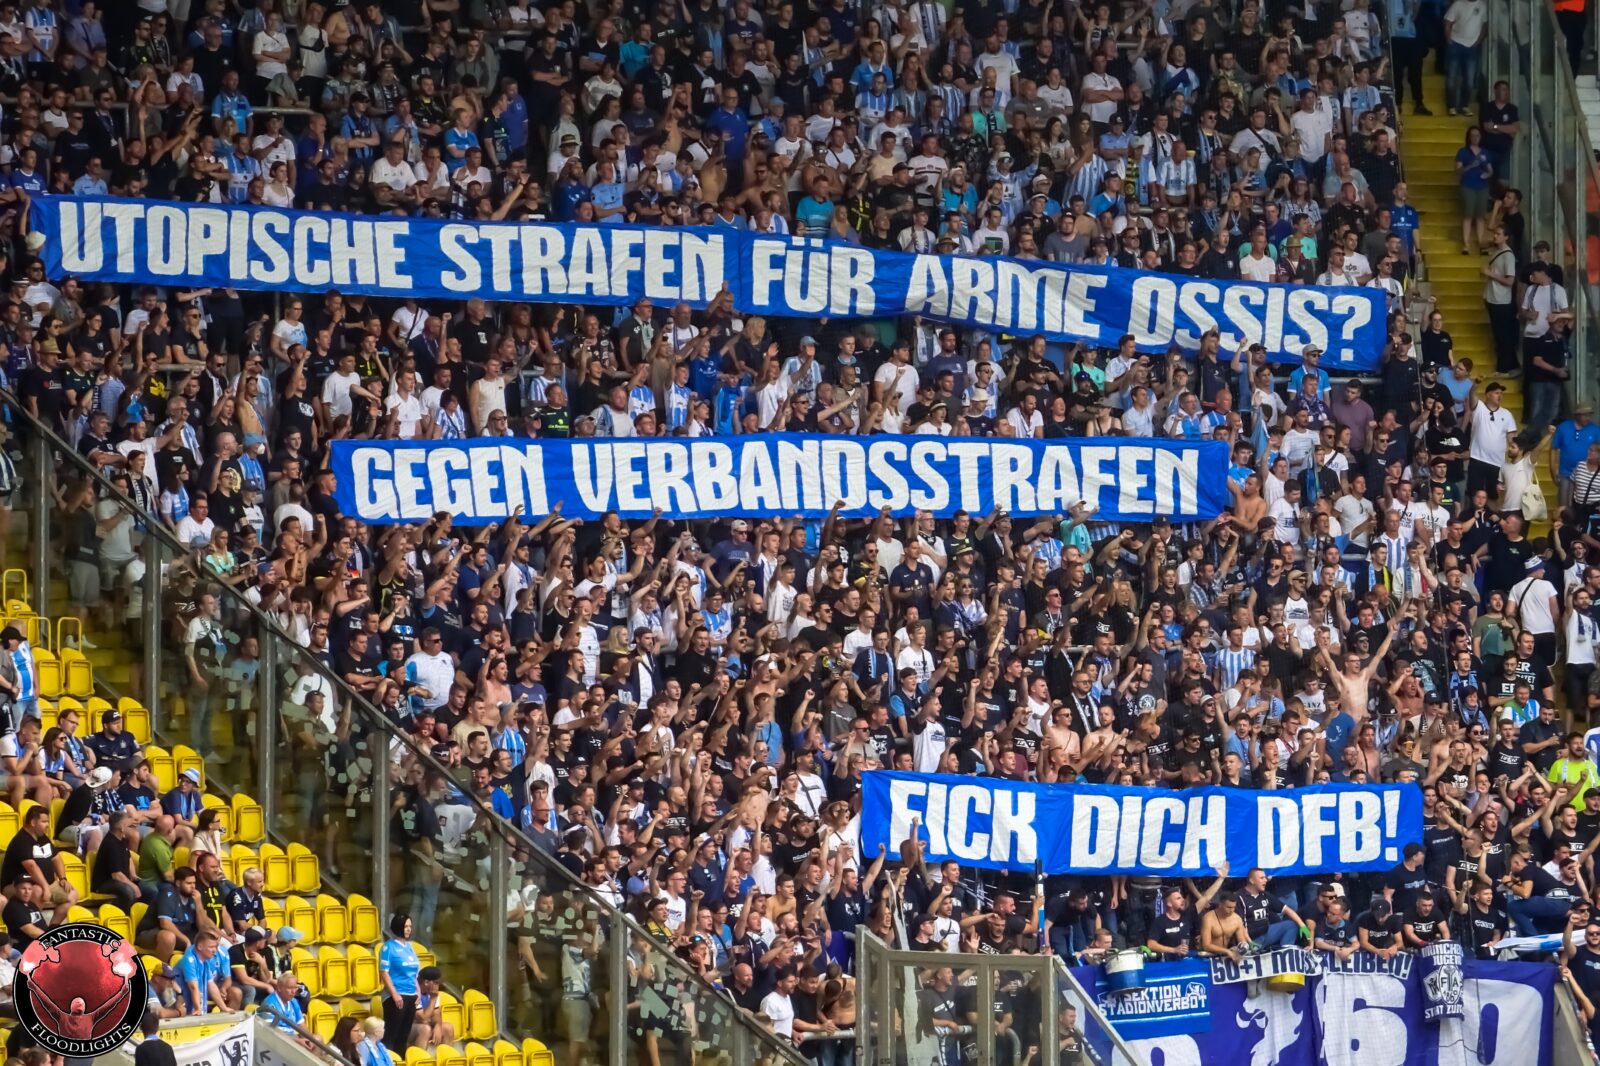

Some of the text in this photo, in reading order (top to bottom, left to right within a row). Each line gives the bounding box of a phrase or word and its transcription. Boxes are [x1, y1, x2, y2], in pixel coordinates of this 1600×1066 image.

[59, 201, 1373, 361] UTOPISCHE STRAFEN FÜR ARME OSSIS?
[351, 439, 1200, 520] GEGEN VERBANDSSTRAFEN
[889, 779, 1402, 869] FICK DICH DFB!
[1123, 984, 1181, 1003] SEKTION
[1212, 955, 1263, 983] 50+1
[1321, 949, 1414, 979] LEIBEN!
[1099, 995, 1207, 1016] STADIONVERBOT
